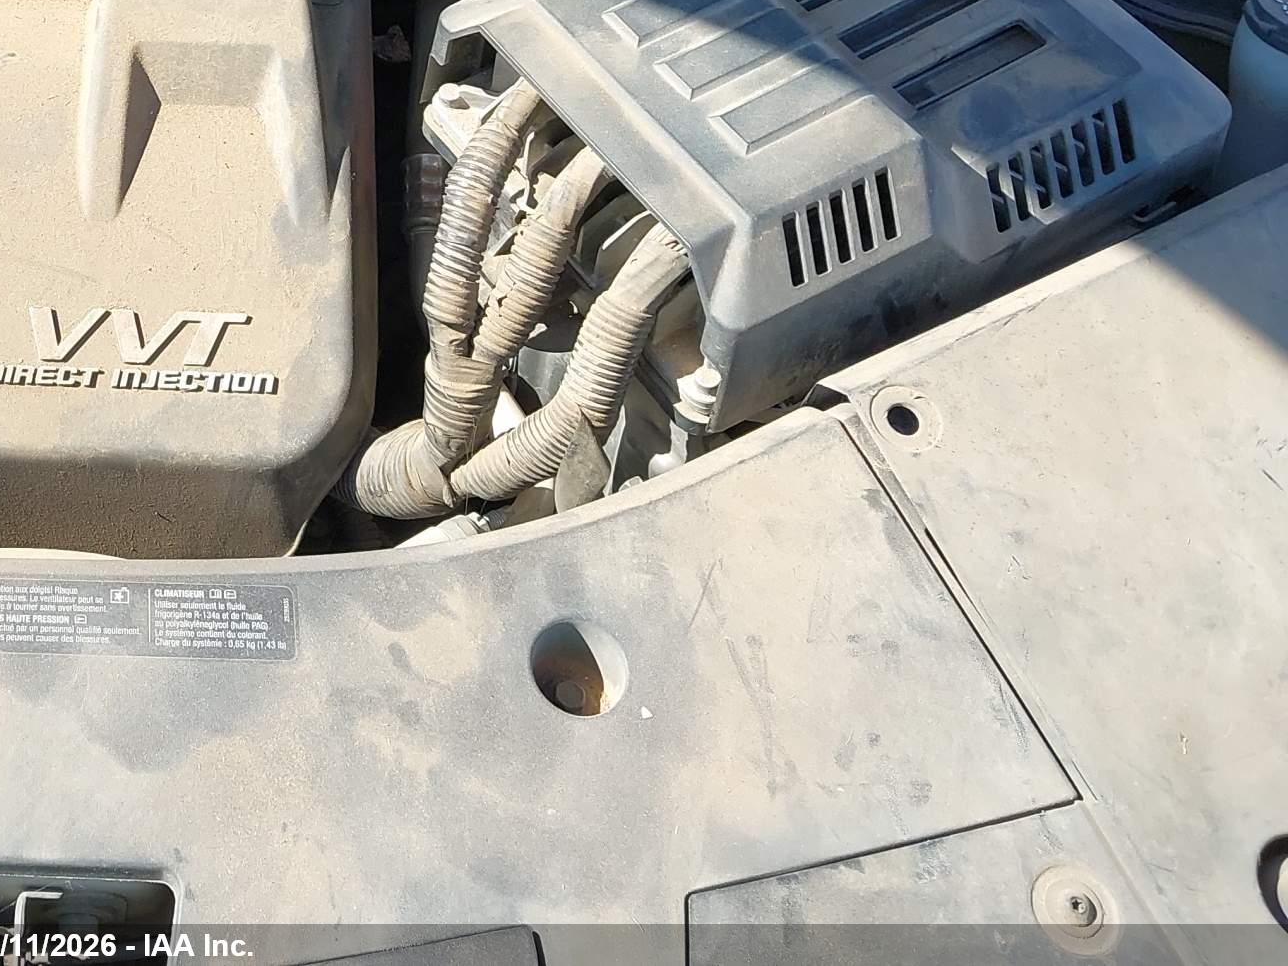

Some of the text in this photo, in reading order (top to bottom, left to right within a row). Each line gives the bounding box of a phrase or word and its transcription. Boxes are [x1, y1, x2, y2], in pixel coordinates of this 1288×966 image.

[28, 306, 252, 366] VVT
[112, 368, 279, 395] INJECTION
[54, 586, 79, 597] Risque
[154, 589, 205, 598] CLIMATISEUR
[39, 595, 77, 603] ventilateur
[154, 600, 178, 609] Utiliser
[226, 601, 246, 610] fluide
[6, 614, 31, 623] HAUTE
[32, 614, 70, 624] PRESSION
[194, 610, 221, 619] R-134a
[39, 624, 74, 635] personnel
[196, 630, 225, 638] contient
[226, 630, 236, 639] du
[60, 634, 74, 642] des
[154, 637, 180, 649] Charge
[182, 638, 191, 647] du
[246, 640, 256, 650] kg
